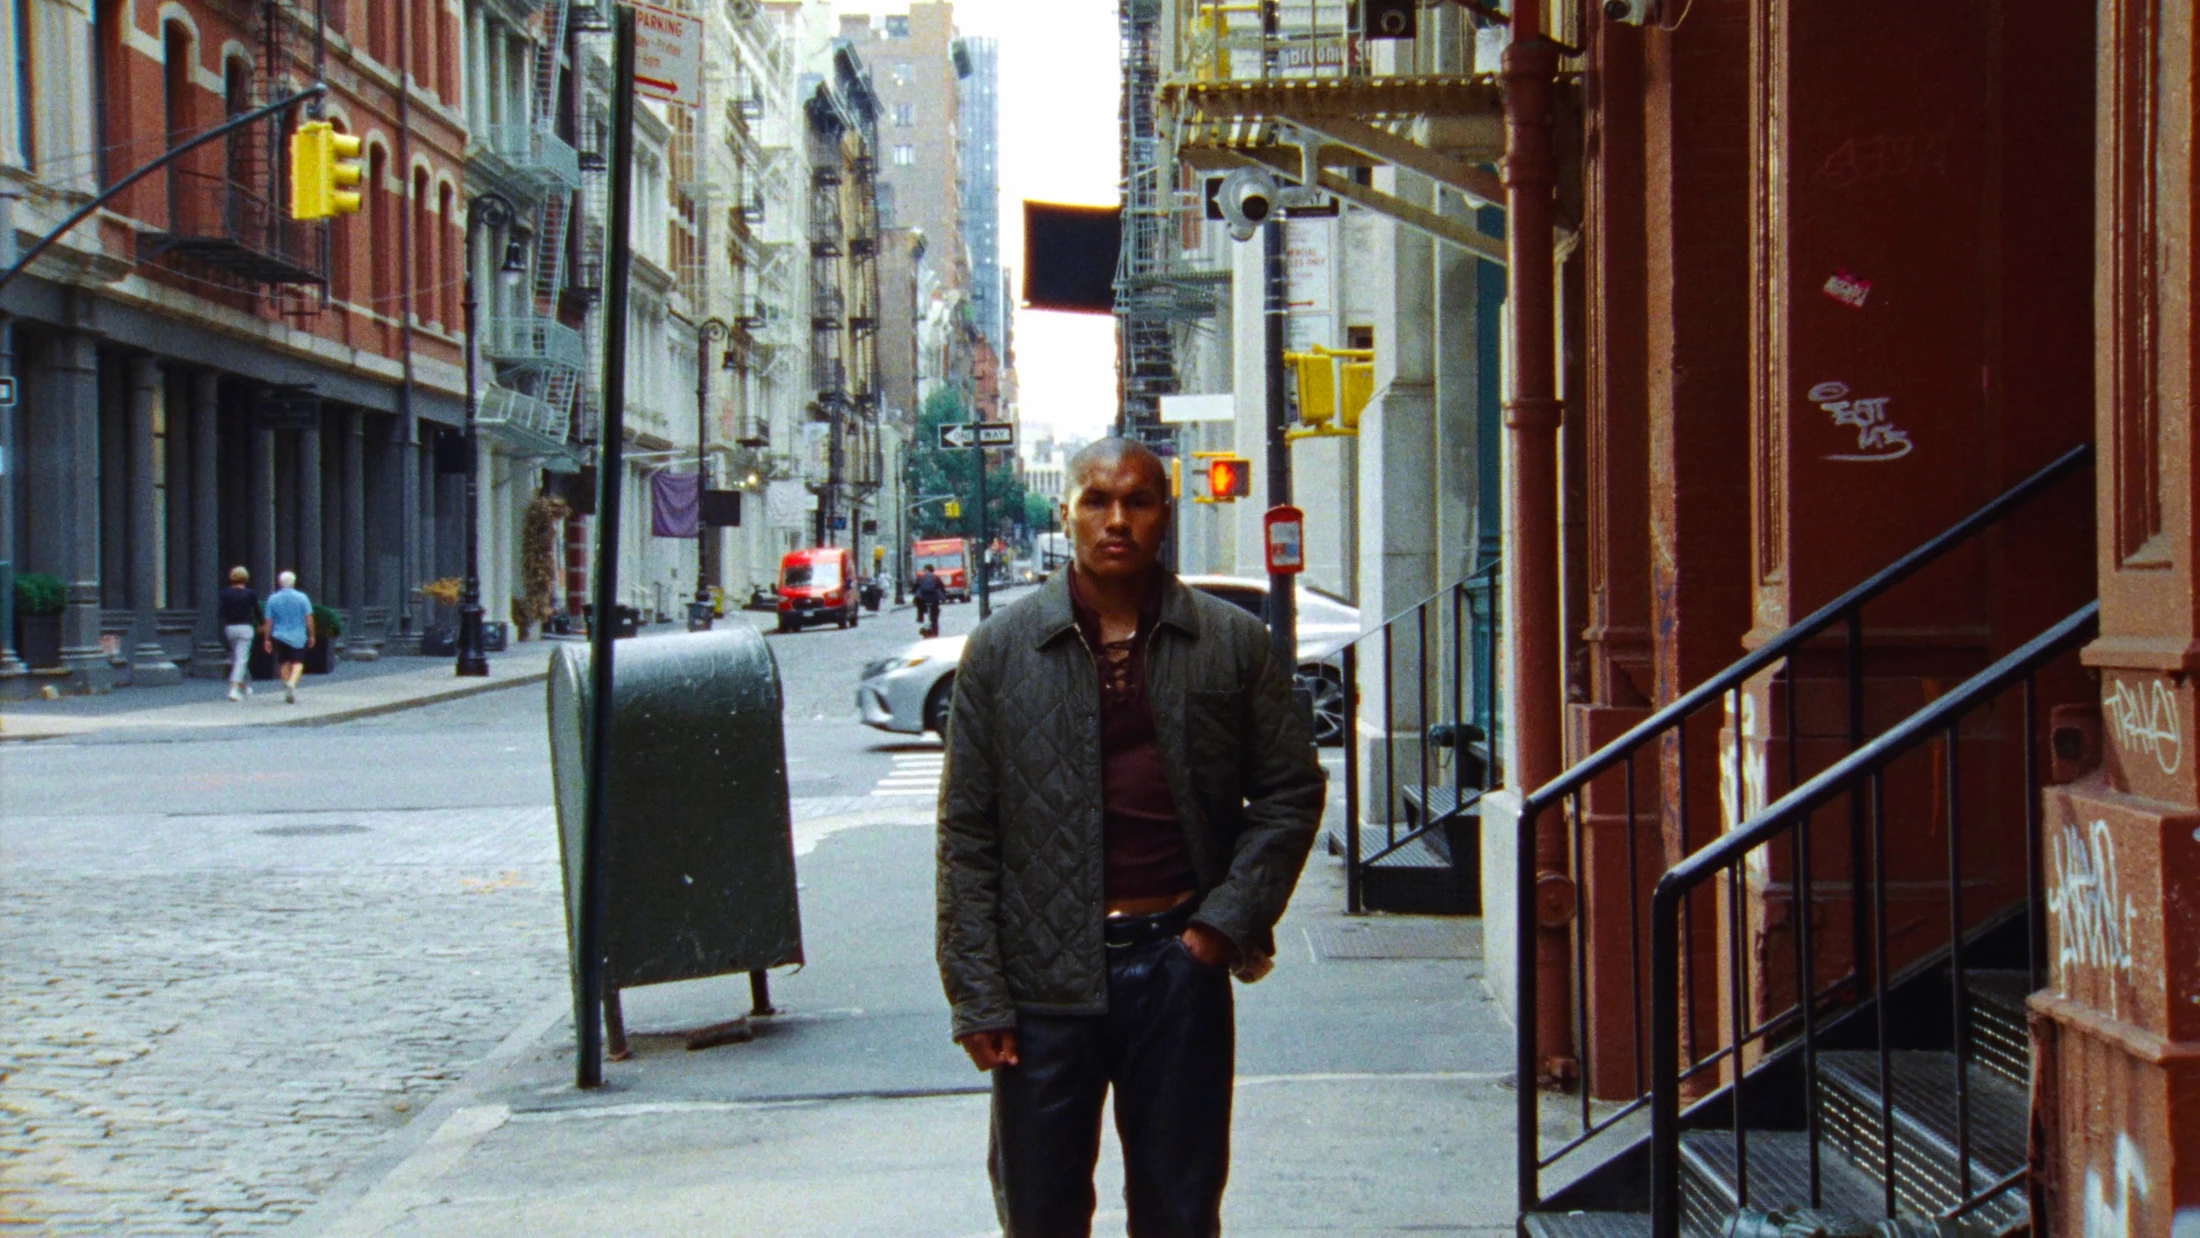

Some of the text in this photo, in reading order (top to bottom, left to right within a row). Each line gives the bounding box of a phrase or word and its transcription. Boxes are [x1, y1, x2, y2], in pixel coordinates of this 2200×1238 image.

[637, 11, 682, 37] PARKING
[954, 431, 1005, 441] ONE WAY
